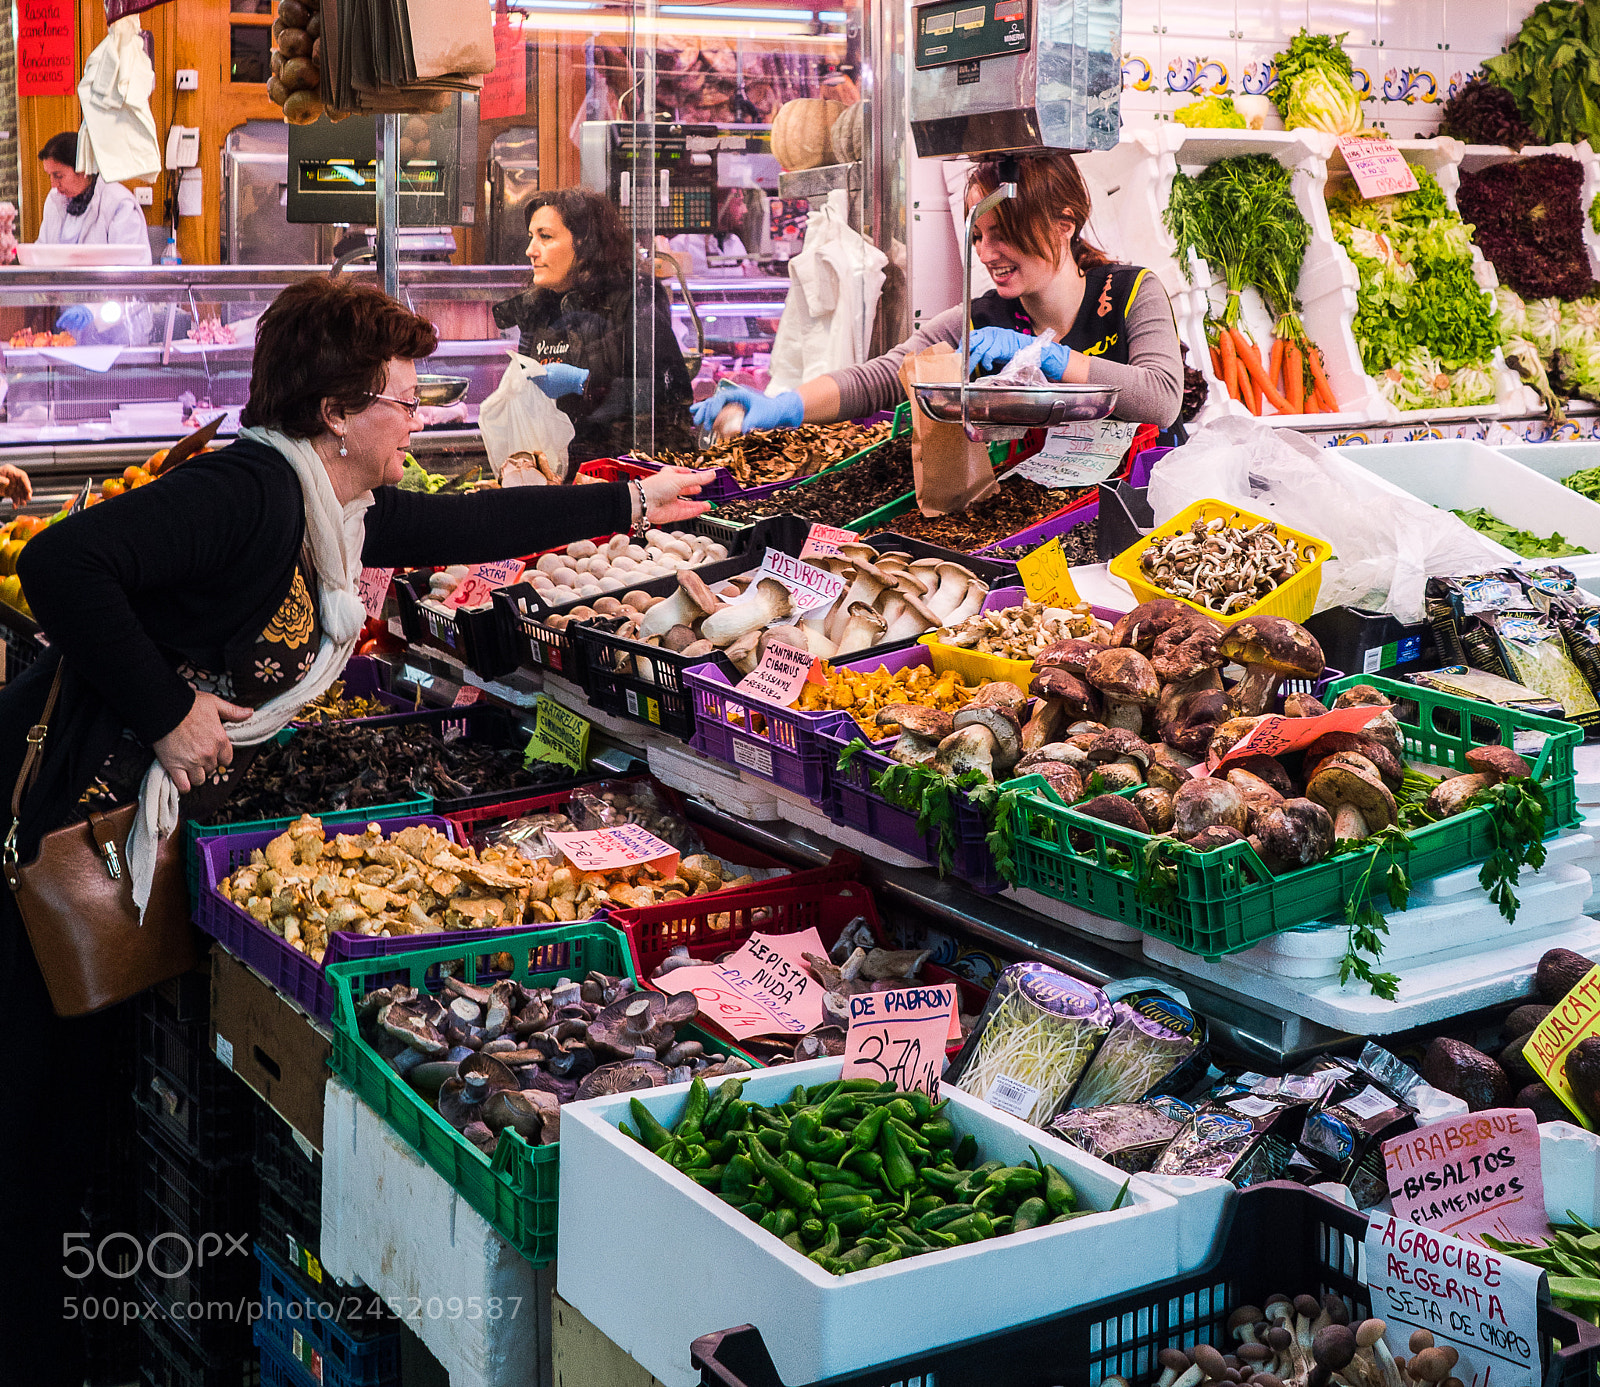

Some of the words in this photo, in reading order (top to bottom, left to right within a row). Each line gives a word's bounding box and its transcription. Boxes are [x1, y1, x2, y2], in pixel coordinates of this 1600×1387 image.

[480, 565, 507, 581] EXTRA
[765, 657, 800, 678] CIBARIUS
[751, 968, 794, 1006] NUDA
[1026, 975, 1090, 1010] tugas
[850, 996, 876, 1020] DE
[884, 989, 952, 1014] PADRON
[1450, 1310, 1475, 1337] DE
[1479, 1321, 1532, 1359] CHOPO
